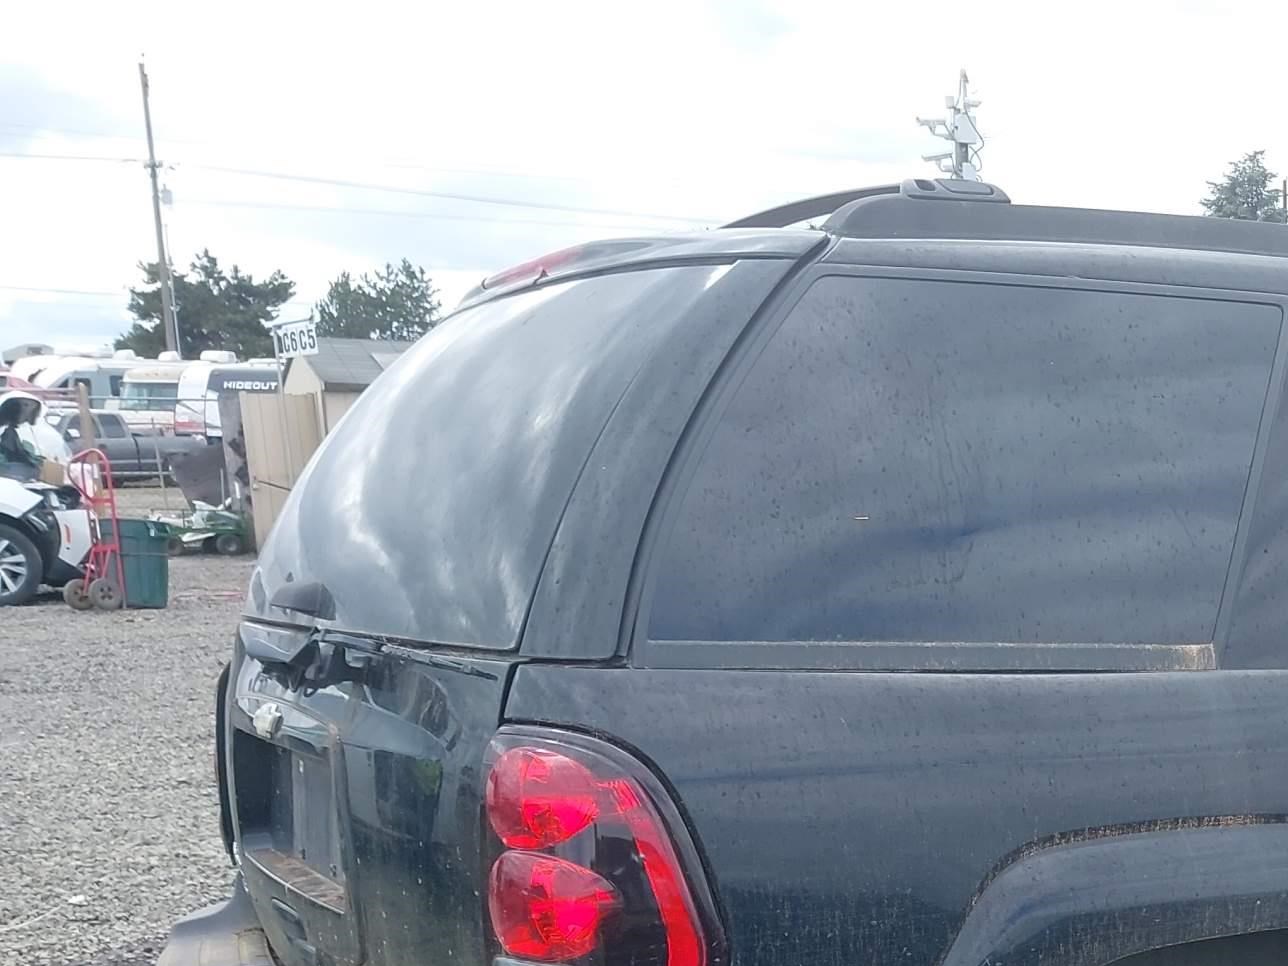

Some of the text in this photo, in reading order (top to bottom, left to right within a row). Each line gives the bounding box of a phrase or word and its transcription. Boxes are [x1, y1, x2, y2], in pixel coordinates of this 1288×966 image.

[282, 329, 316, 353] C6 C5
[223, 381, 278, 390] HIDEOUT
